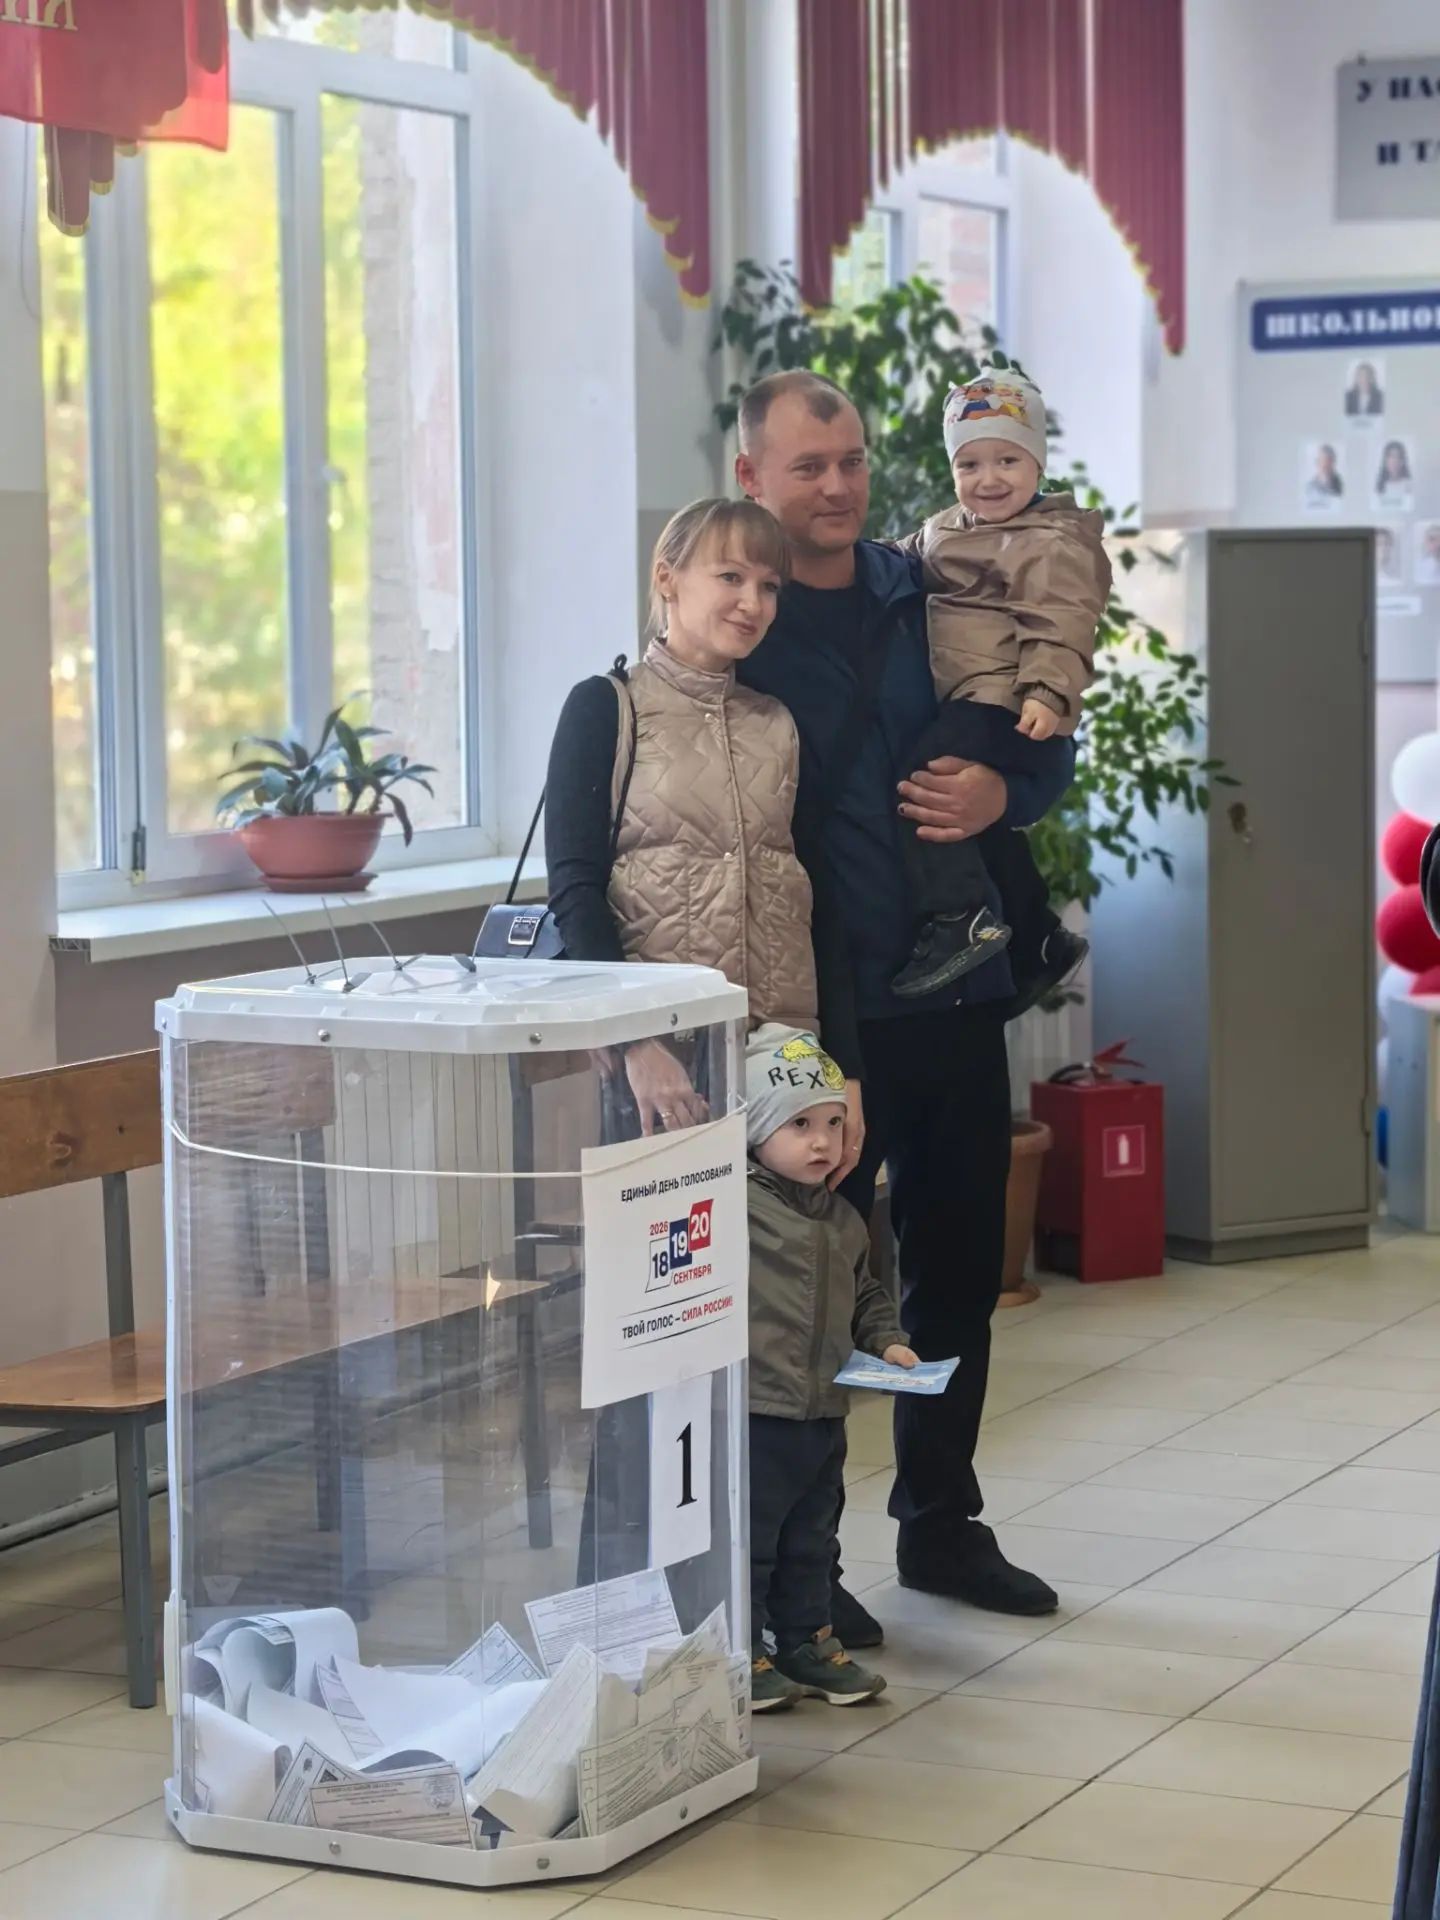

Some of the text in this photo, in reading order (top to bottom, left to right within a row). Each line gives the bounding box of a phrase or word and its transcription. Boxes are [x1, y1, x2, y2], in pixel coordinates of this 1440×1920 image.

[767, 1066, 825, 1089] REX
[621, 1163, 733, 1202] ЕДИНЫЙ ДЕНЬ ГОЛОСОВАНИЯ
[649, 1221, 669, 1236] 2026
[652, 1211, 710, 1279] 18 19 20
[673, 1264, 712, 1285] СЕНТЯБРЯ
[622, 1320, 645, 1339] ТВОЙ
[646, 1314, 674, 1333] ГОЛОС
[681, 1306, 703, 1323] СИЛА
[676, 1421, 698, 1508] 1
